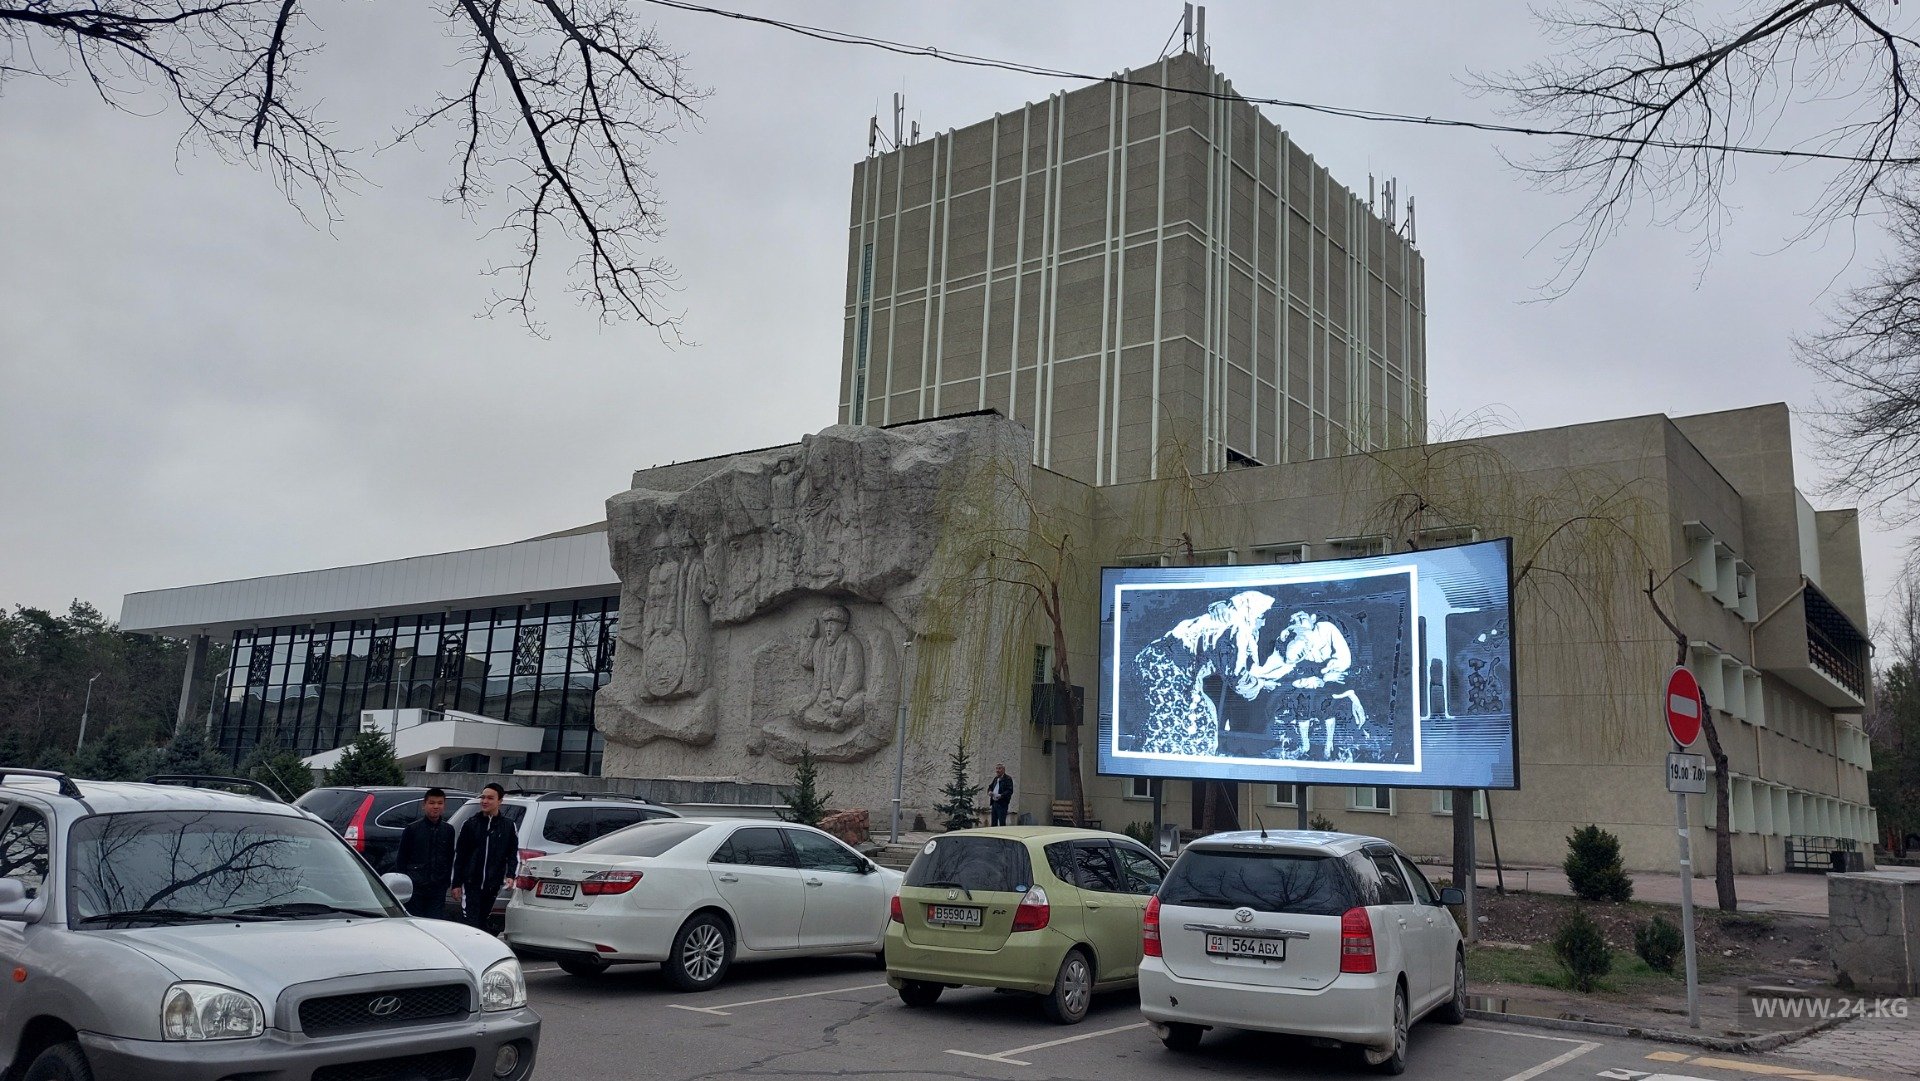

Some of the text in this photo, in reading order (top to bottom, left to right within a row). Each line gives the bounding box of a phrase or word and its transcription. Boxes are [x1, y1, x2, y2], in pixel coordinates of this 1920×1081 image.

[965, 909, 979, 922] AJ
[1211, 936, 1223, 946] 01
[1232, 938, 1256, 954] 564
[1257, 941, 1279, 955] AGX
